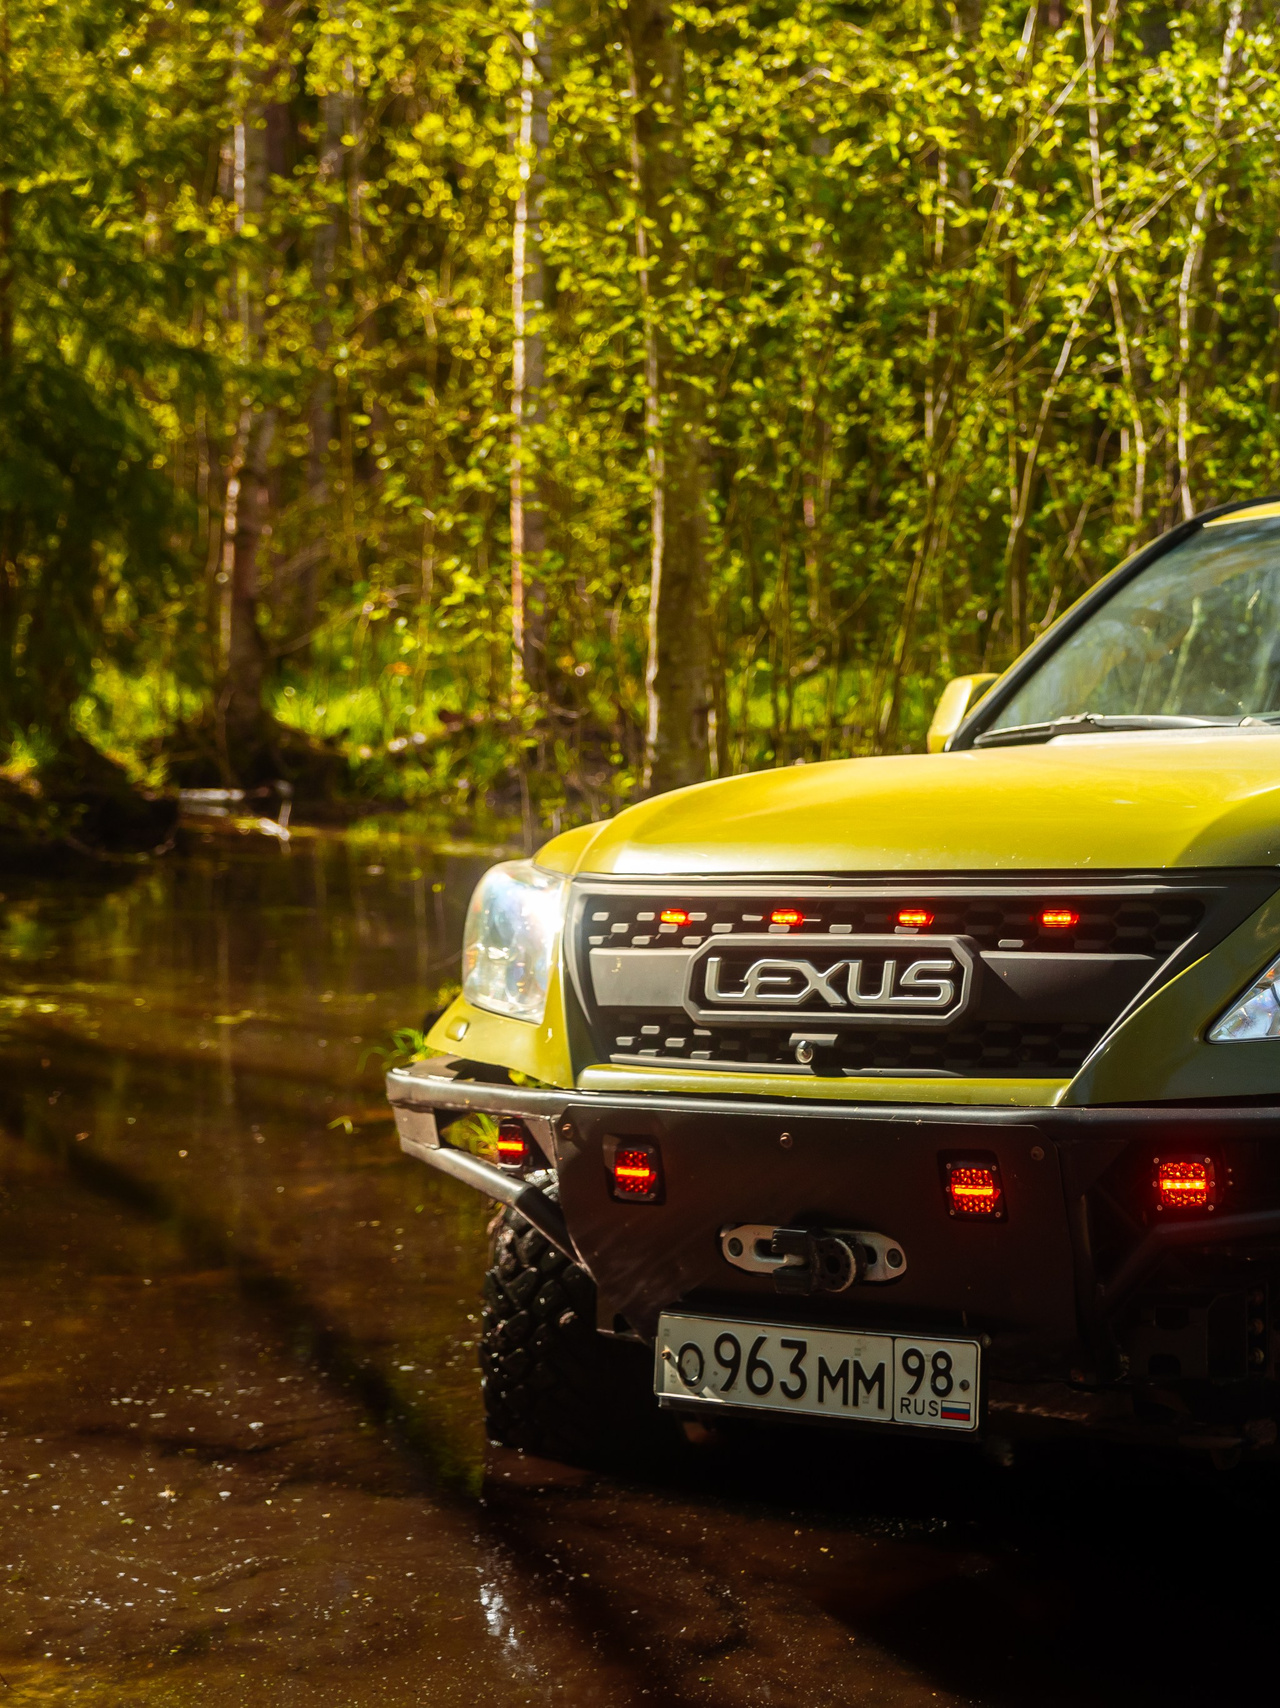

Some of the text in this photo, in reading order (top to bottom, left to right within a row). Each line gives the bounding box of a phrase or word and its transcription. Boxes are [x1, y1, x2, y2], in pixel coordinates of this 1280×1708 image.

[704, 956, 956, 1008] LEXUS
[901, 1347, 954, 1398] 98
[900, 1397, 939, 1417] RUS
